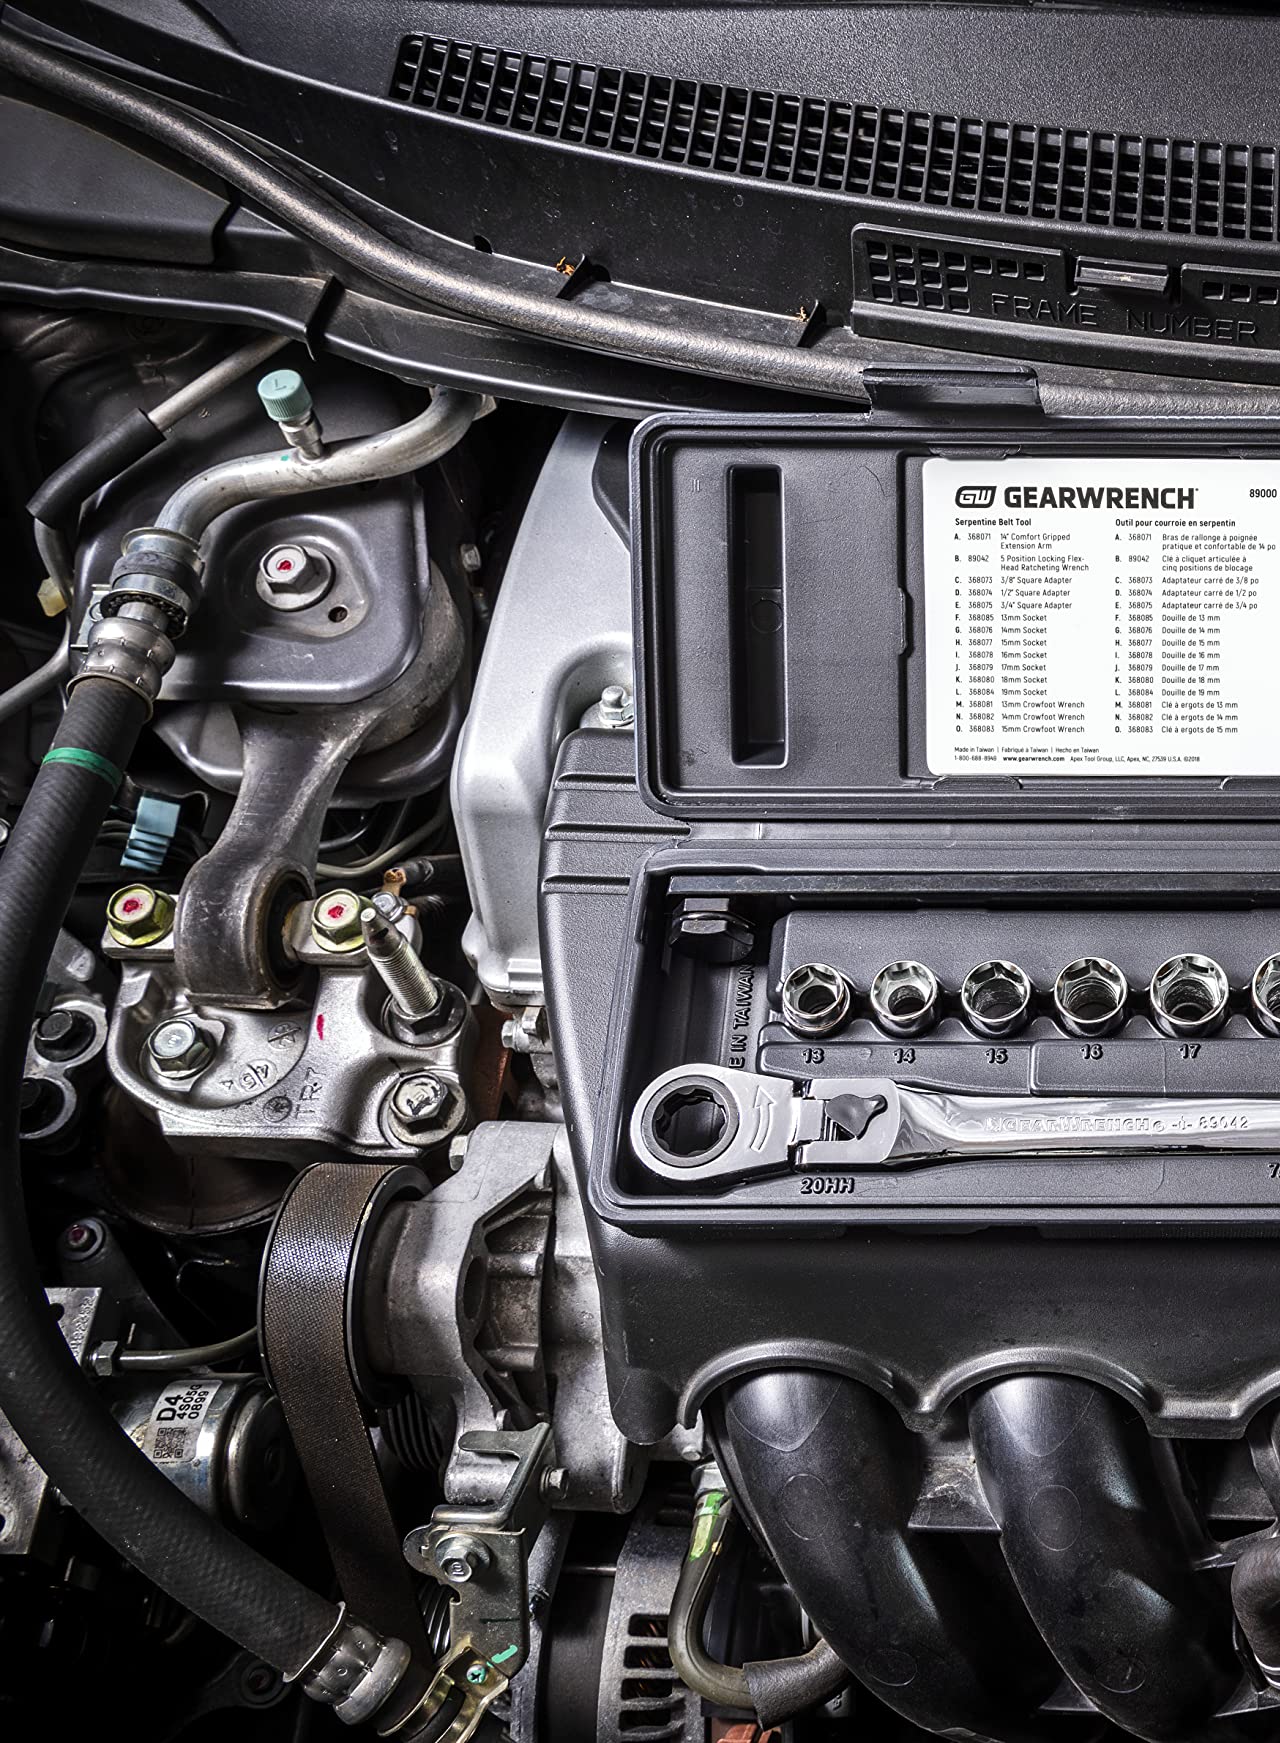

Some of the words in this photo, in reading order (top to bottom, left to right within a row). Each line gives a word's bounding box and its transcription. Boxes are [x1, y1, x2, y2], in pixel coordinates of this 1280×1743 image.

[990, 292, 1098, 326] FRAME
[1126, 309, 1258, 343] NUMBER
[1004, 486, 1195, 510] GEARWRENCH
[1249, 488, 1278, 499] 89000
[955, 518, 996, 527] Serpentine
[998, 518, 1014, 526] Belt
[1016, 518, 1032, 526] Tool
[1115, 518, 1134, 526] Outil
[1135, 520, 1153, 528] pour
[1199, 519, 1236, 528] serpentin
[1011, 533, 1040, 541] Comfort
[1042, 533, 1070, 542] Gripped
[1128, 533, 1152, 541] 368071
[1191, 534, 1221, 542] rallonge
[1000, 542, 1036, 550] Extension
[954, 554, 962, 562] B.
[968, 554, 989, 562] 89042
[1006, 554, 1036, 562] Position
[1038, 555, 1066, 564] Locking
[1021, 564, 1060, 572] Ratcheting
[954, 576, 962, 584] C.
[968, 576, 992, 584] 368073
[1017, 576, 1042, 584] Square
[1044, 576, 1072, 585] Adapter
[1015, 588, 1040, 597] Square
[1042, 589, 1070, 597] Adapter
[968, 601, 993, 609] 368075
[1017, 602, 1042, 610] Square
[1044, 602, 1072, 610] Adapter
[732, 963, 755, 1030] TAIWAN
[730, 1035, 747, 1052] IN
[802, 1048, 825, 1064] 13
[894, 1048, 916, 1064] 14
[985, 1048, 1008, 1064] 15
[1080, 1044, 1103, 1060] 16
[1179, 1044, 1201, 1059] 17
[799, 1177, 856, 1195] 20HH
[156, 1394, 183, 1421] D4
